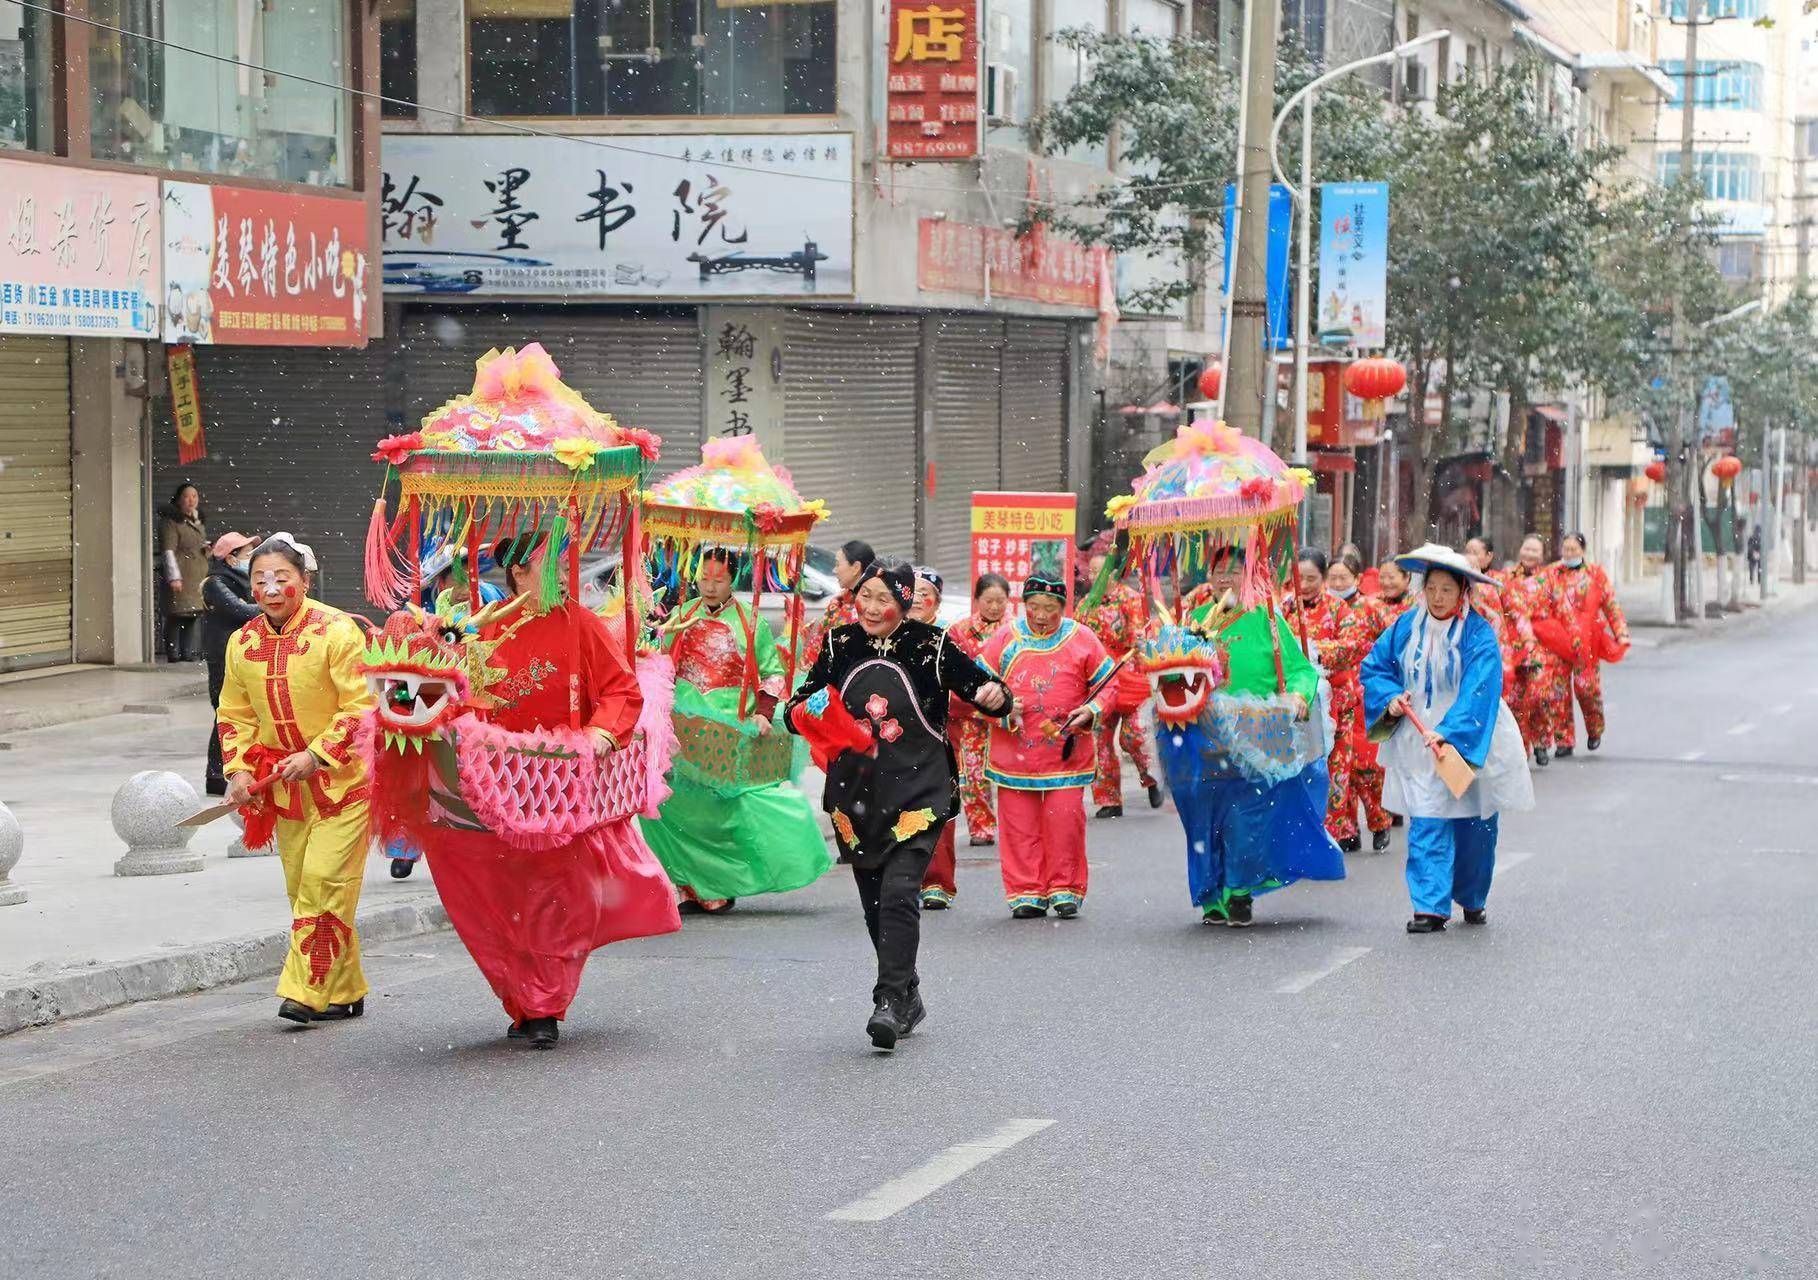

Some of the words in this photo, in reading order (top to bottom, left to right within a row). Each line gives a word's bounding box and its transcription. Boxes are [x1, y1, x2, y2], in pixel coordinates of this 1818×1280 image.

[894, 5, 966, 62] 店
[382, 168, 748, 251] 翰墨书院
[212, 212, 347, 298] 美琴特色小吃
[28, 286, 58, 307] 小五金
[983, 511, 1063, 531] 美琴特色小吃
